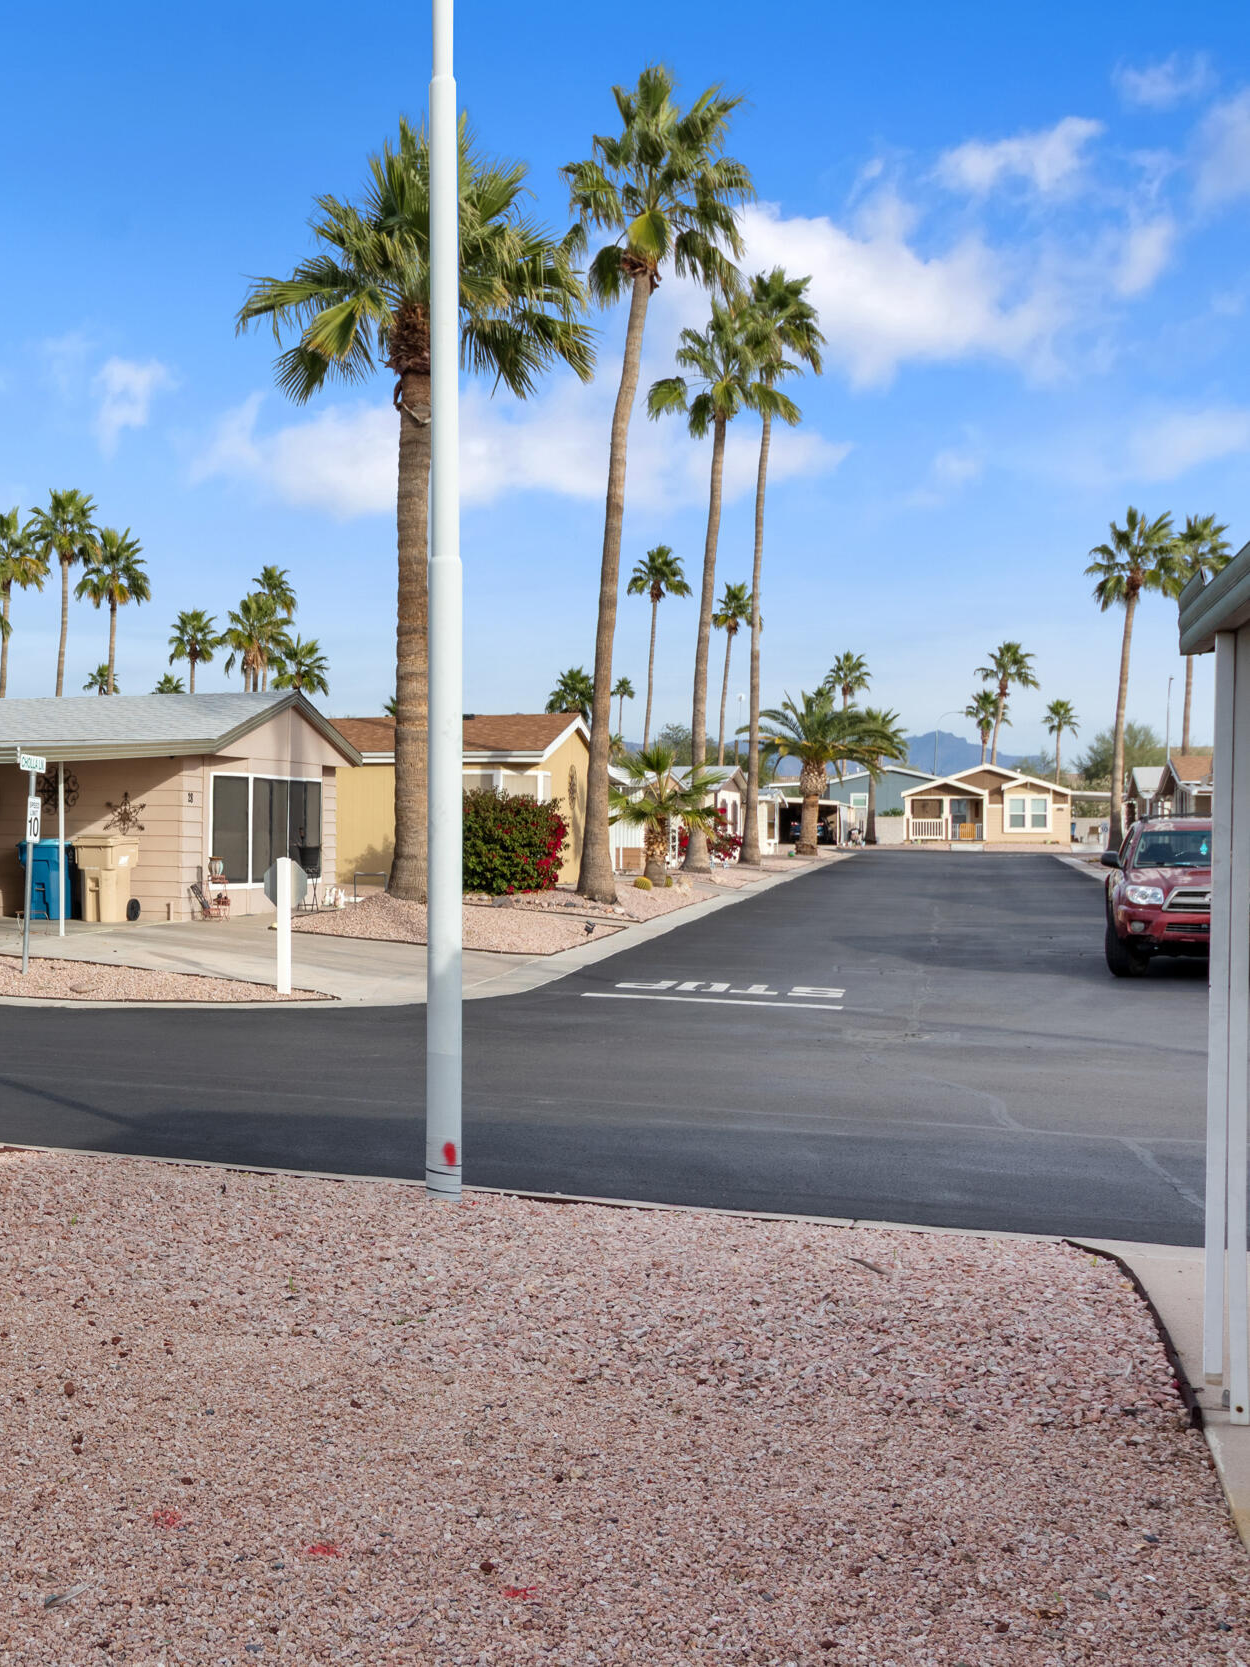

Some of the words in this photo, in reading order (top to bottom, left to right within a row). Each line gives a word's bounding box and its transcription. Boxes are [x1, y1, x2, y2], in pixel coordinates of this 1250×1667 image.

[21, 756, 37, 769] CHOLLA
[28, 816, 39, 837] 10
[614, 980, 847, 998] STOP
